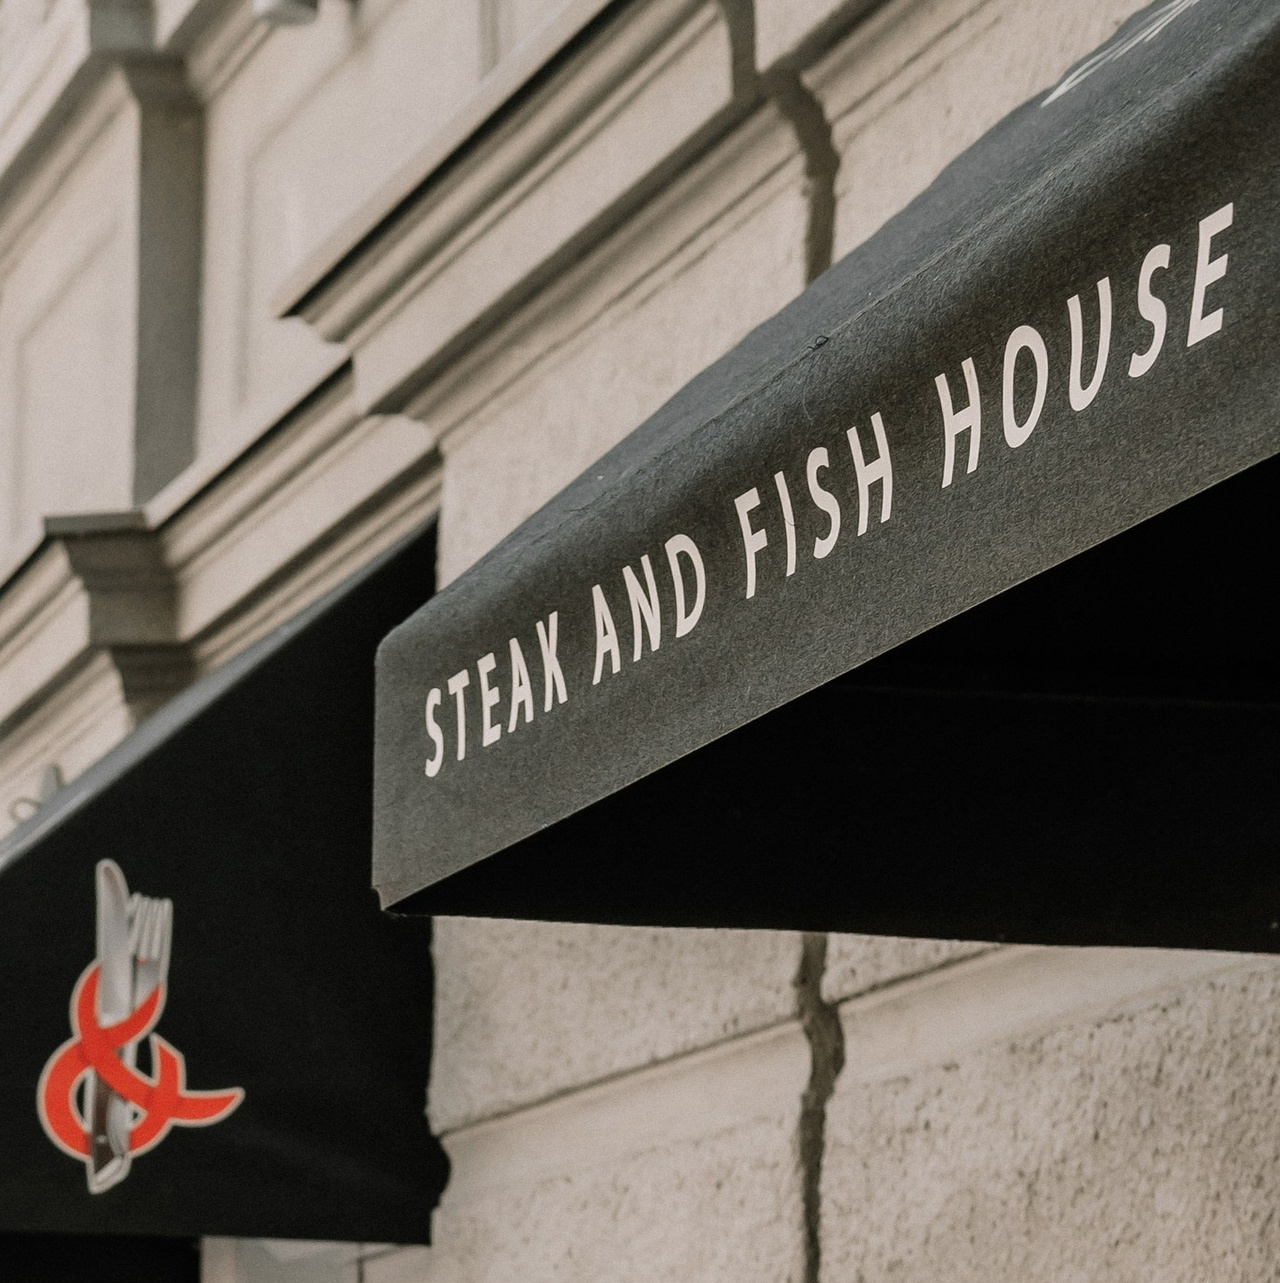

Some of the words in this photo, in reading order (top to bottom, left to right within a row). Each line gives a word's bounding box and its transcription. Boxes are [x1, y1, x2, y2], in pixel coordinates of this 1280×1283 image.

[424, 610, 568, 778] STEAK
[592, 533, 706, 686] AND
[733, 411, 894, 600] FISH
[934, 202, 1234, 489] HOUSE
